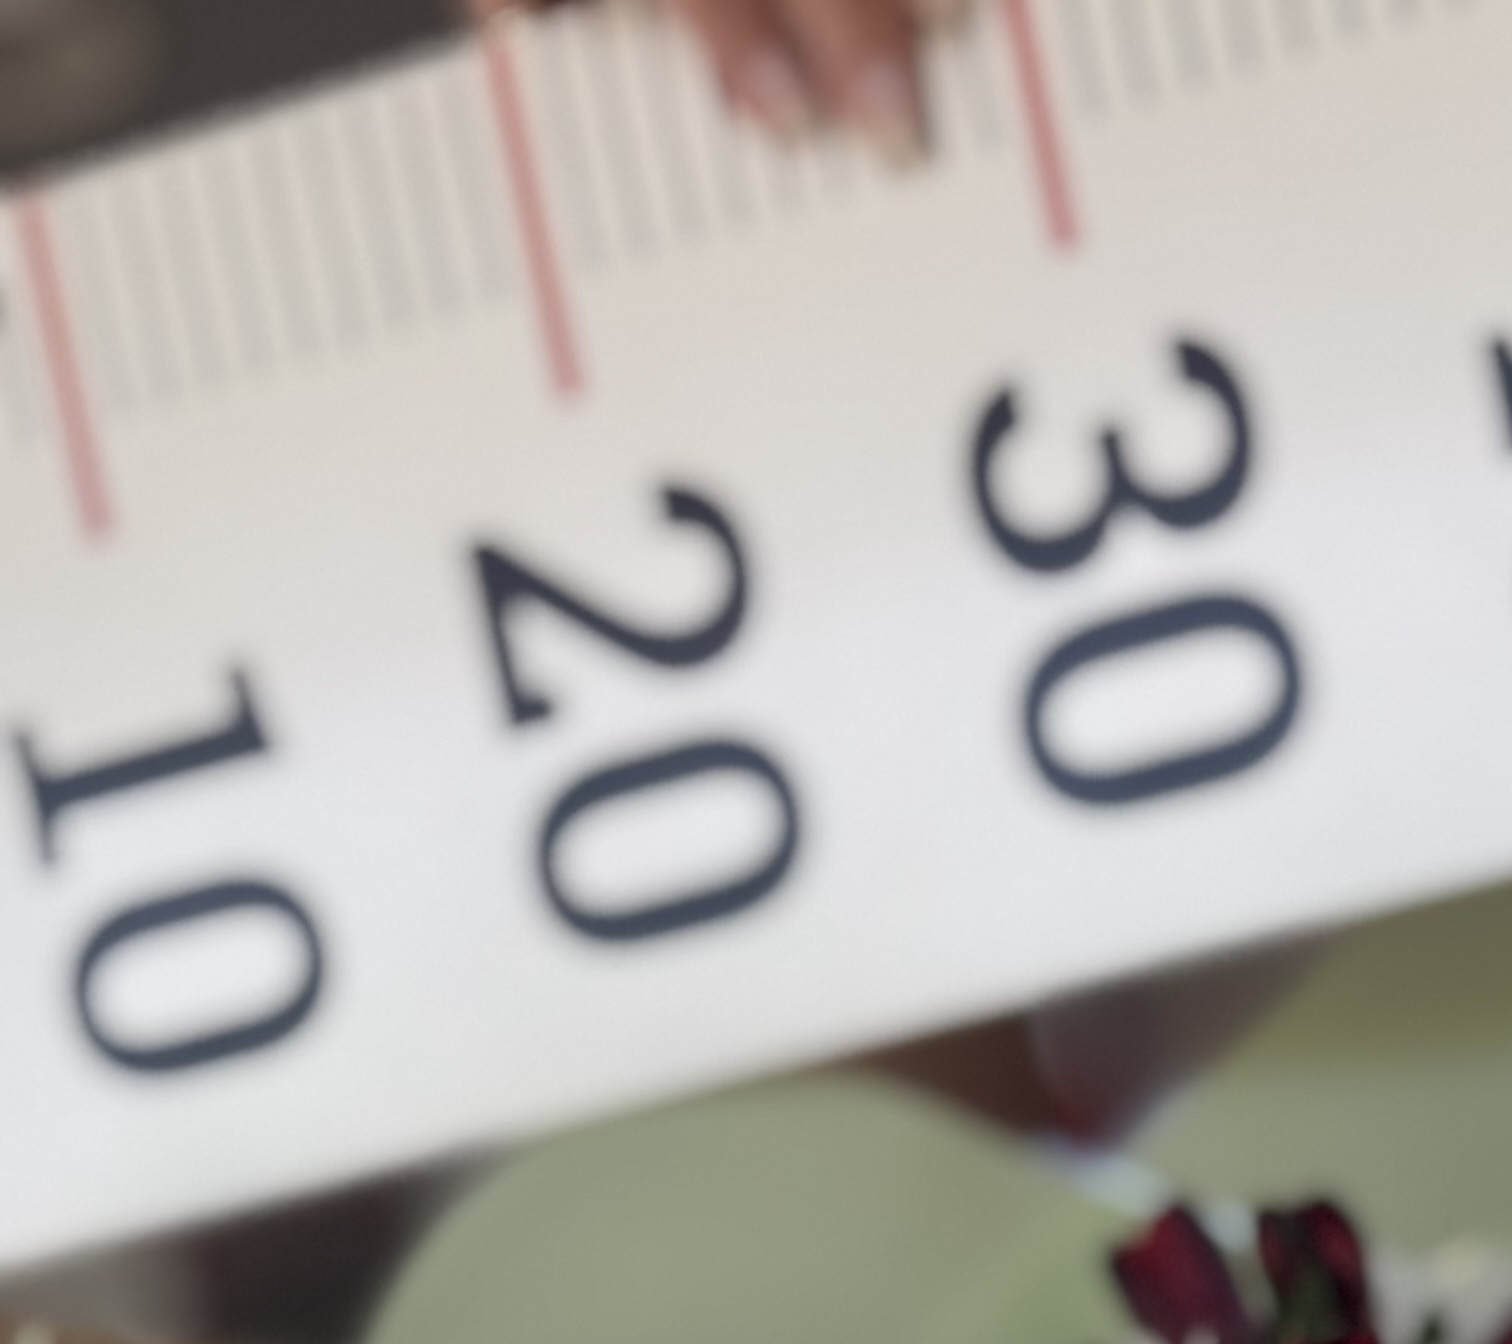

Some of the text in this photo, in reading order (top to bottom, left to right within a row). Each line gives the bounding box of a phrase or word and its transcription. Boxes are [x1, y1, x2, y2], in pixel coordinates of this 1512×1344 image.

[470, 484, 803, 945] 20
[968, 335, 1304, 808] 30
[14, 664, 325, 1077] 10
